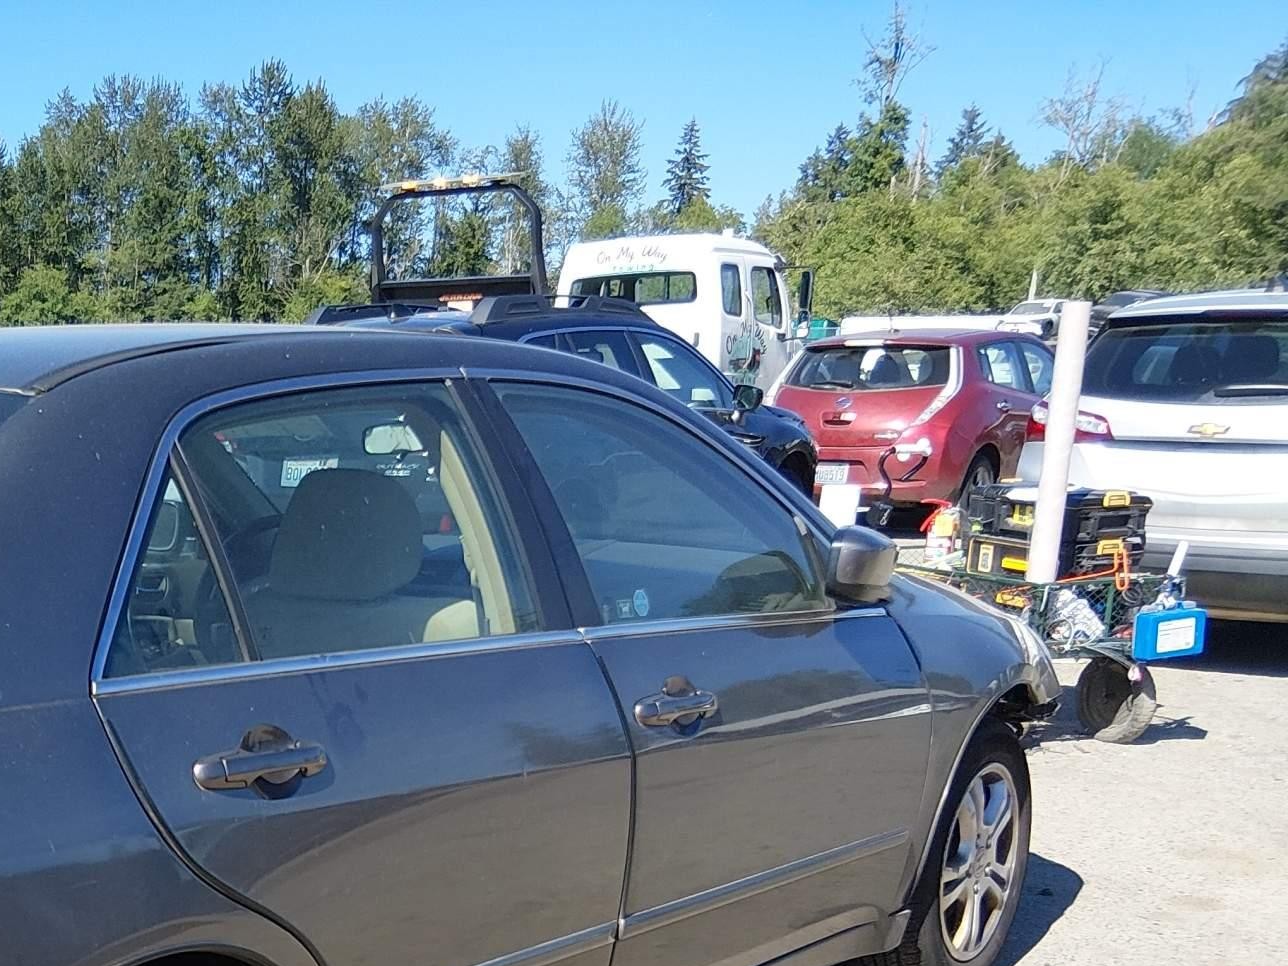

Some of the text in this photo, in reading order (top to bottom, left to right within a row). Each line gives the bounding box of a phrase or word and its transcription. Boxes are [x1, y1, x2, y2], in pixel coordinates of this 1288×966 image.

[597, 245, 669, 264] On My Way
[754, 322, 768, 356] Way
